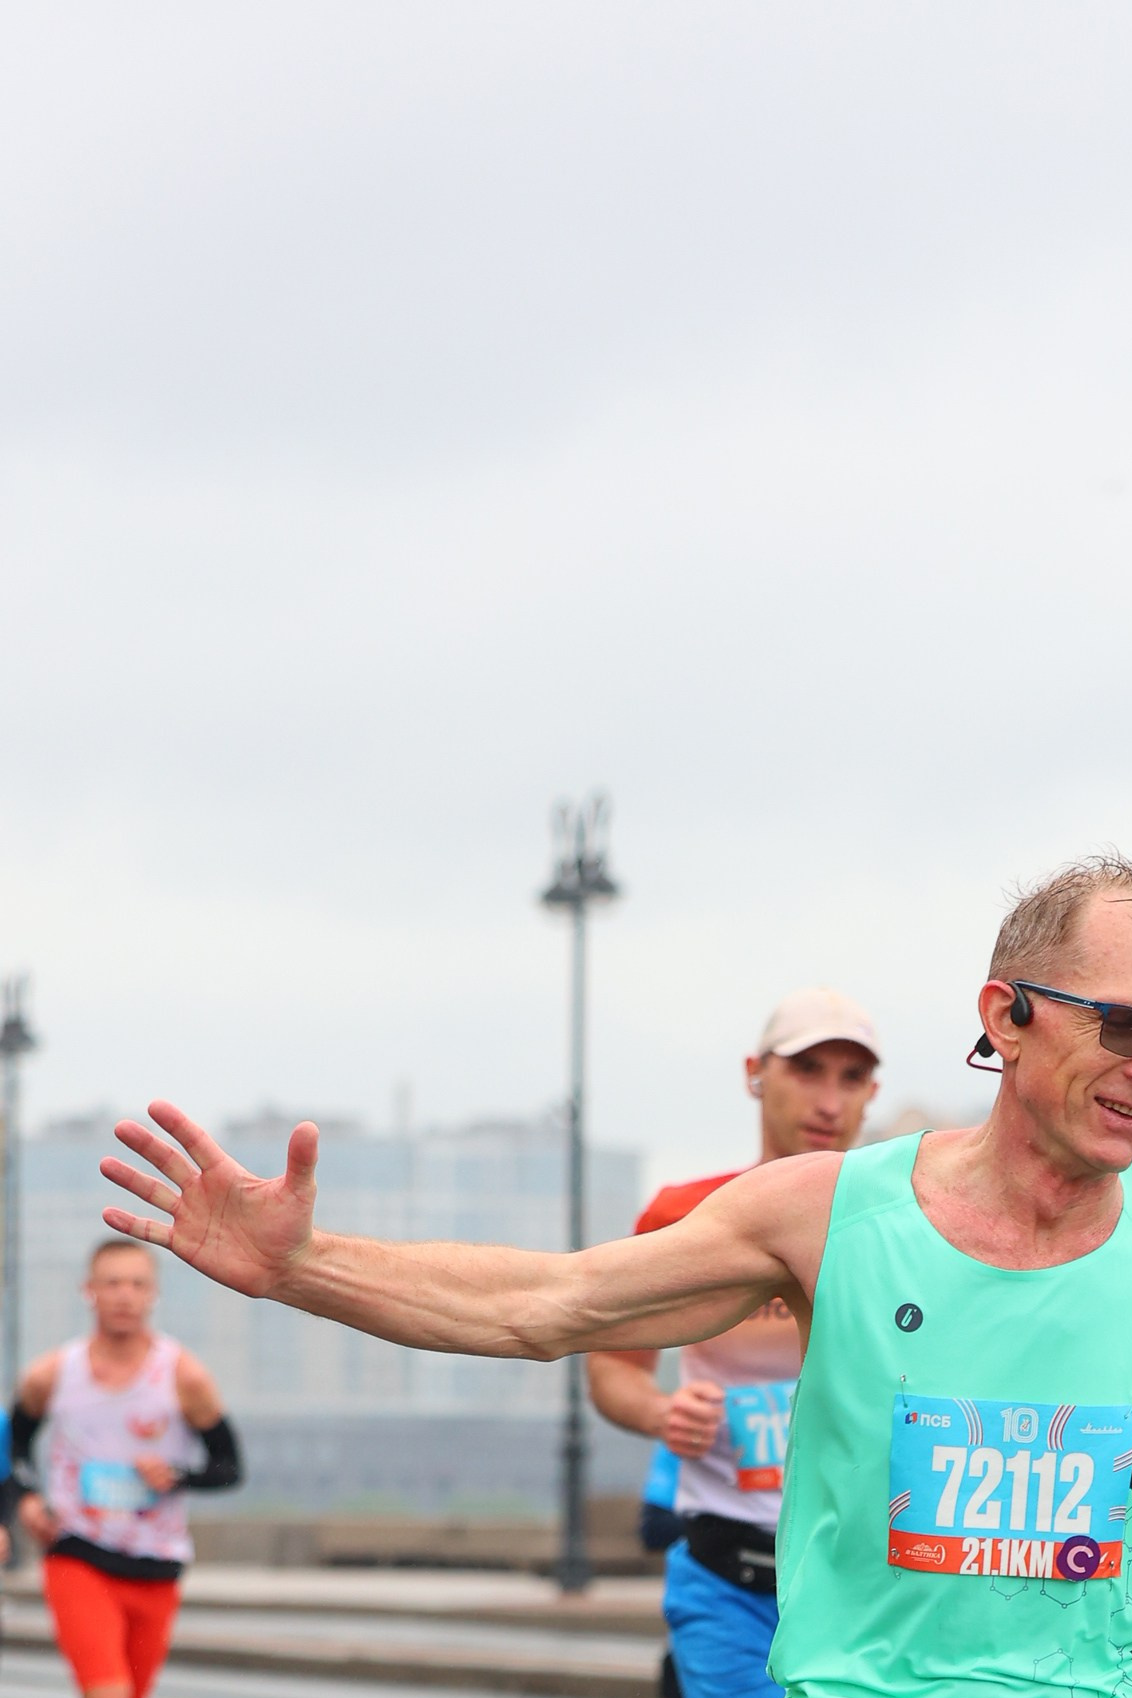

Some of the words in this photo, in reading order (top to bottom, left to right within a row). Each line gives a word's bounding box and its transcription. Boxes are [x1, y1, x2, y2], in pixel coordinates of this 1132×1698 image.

[746, 1411, 791, 1463] 71
[920, 1413, 951, 1428] ПСБ
[1000, 1407, 1039, 1443] 10
[931, 1445, 1095, 1533] 72112
[959, 1536, 1055, 1578] 21.1KM
[1066, 1546, 1094, 1573] C
